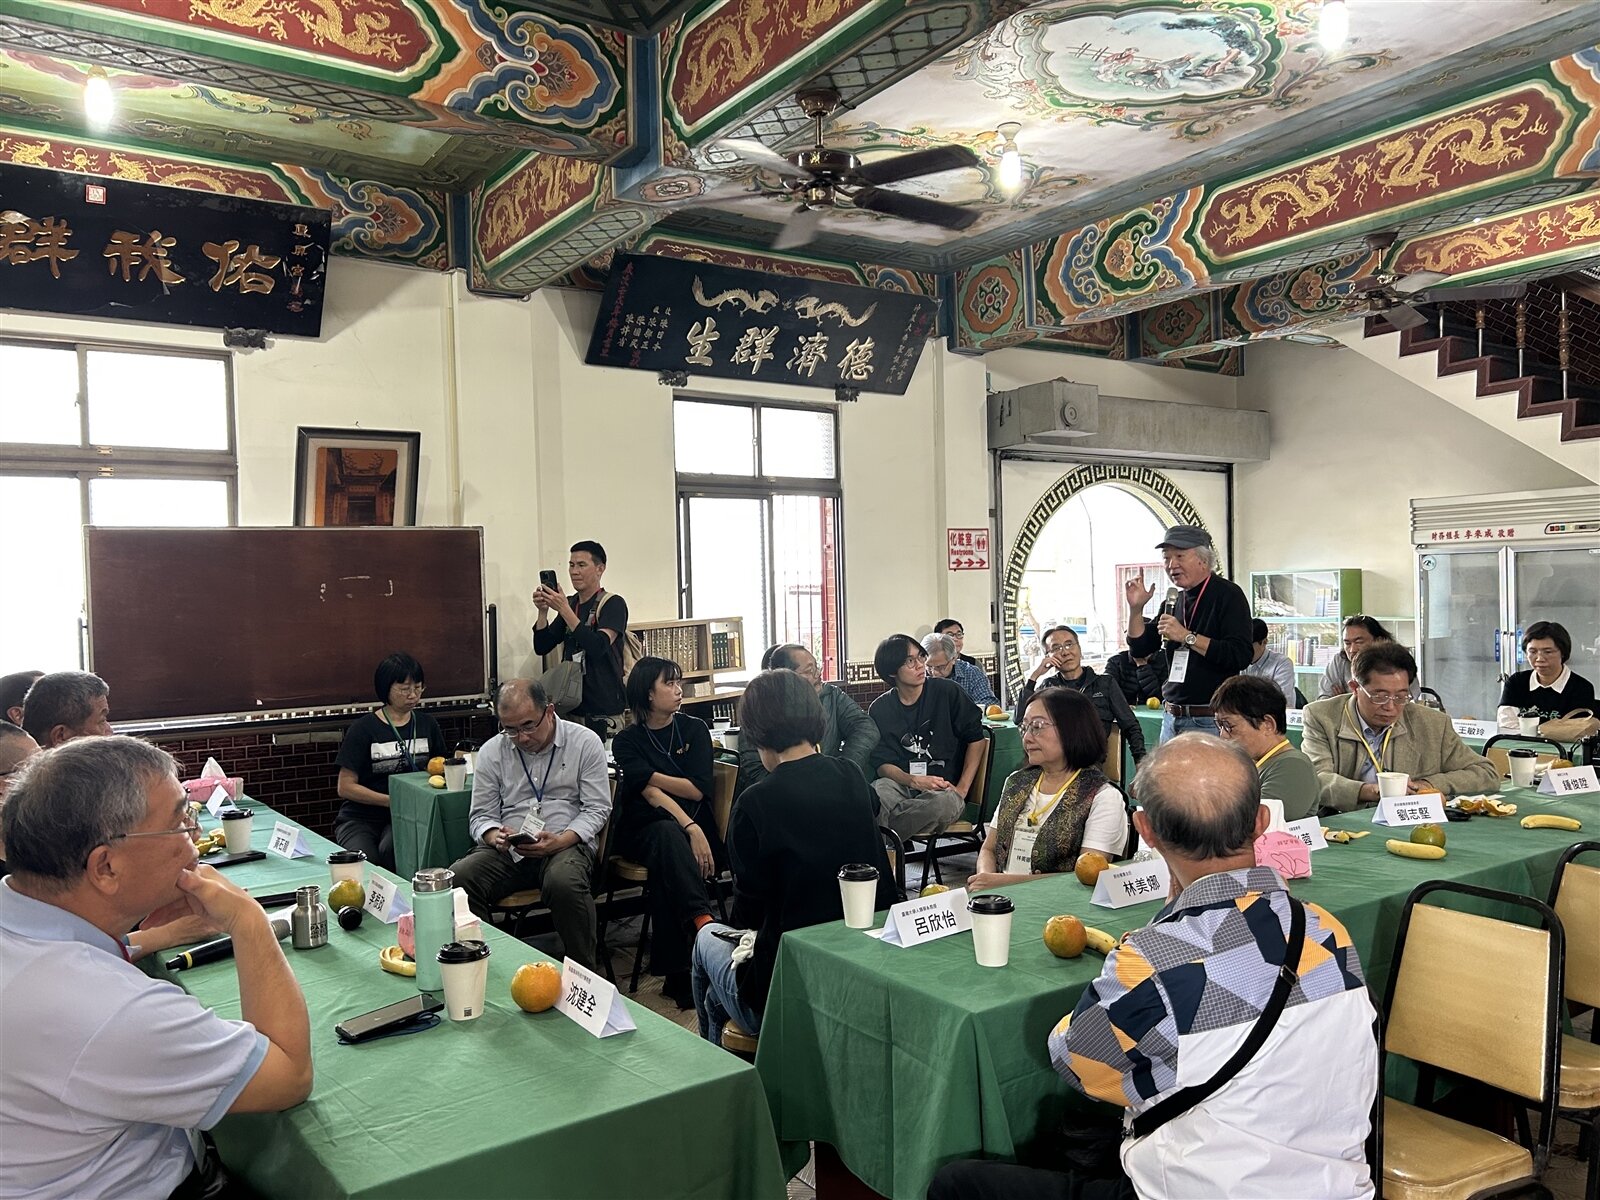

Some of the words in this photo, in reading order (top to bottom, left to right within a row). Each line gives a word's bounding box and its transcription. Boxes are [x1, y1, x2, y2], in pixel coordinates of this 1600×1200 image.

[685, 317, 875, 380] 德濟群生
[1458, 726, 1485, 736] 王敏玲
[1396, 806, 1431, 821] 劉志堅
[914, 909, 957, 937] 呂欣怡
[565, 981, 597, 1018] 沈建全
